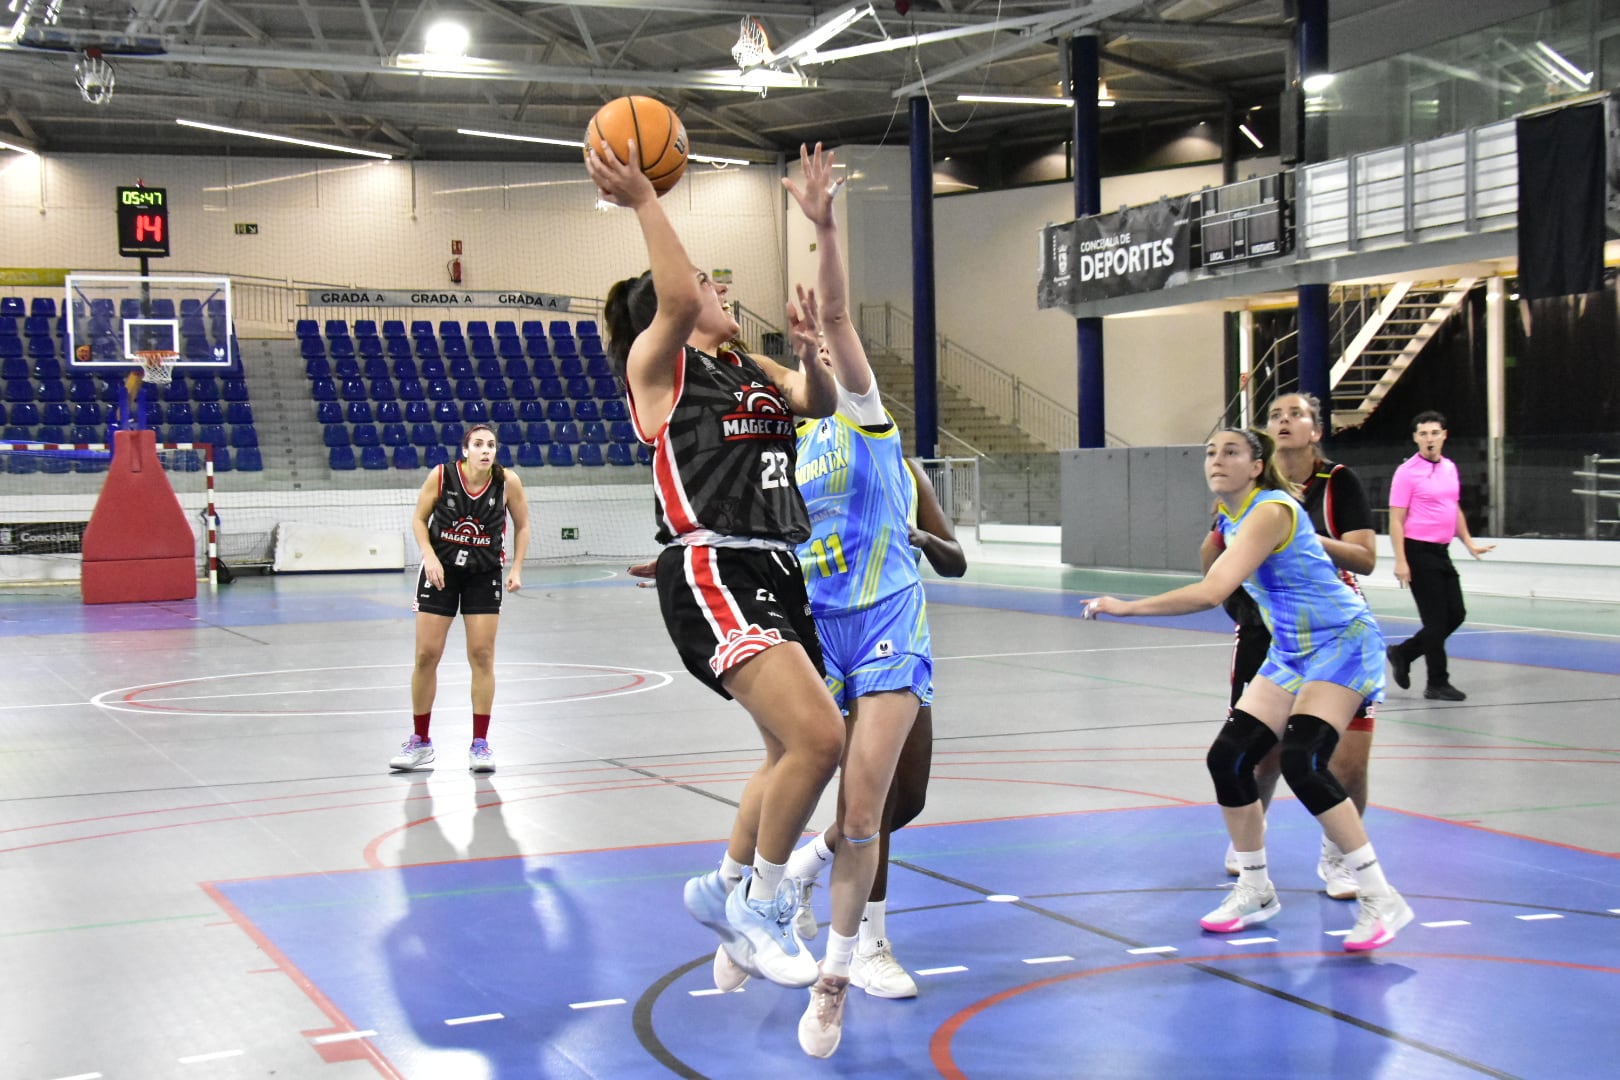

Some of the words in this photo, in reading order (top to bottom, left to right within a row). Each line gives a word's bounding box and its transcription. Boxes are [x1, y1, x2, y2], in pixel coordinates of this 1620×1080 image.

[122, 191, 162, 205] 05:47
[136, 215, 162, 242] 14
[1119, 232, 1131, 245] DE
[1080, 238, 1175, 282] DEPORTES
[320, 292, 370, 304] GRADA
[375, 293, 385, 303] A
[411, 293, 459, 304] GRADA
[464, 294, 473, 304] A
[498, 294, 544, 307] GRADA
[549, 297, 558, 308] A
[722, 418, 772, 437] MAGEC
[761, 451, 789, 490] 23
[795, 447, 847, 487] NDRATX
[440, 531, 470, 544] MAGEC
[473, 536, 491, 545] TIAS
[454, 549, 469, 566] 6
[810, 533, 848, 578] 11
